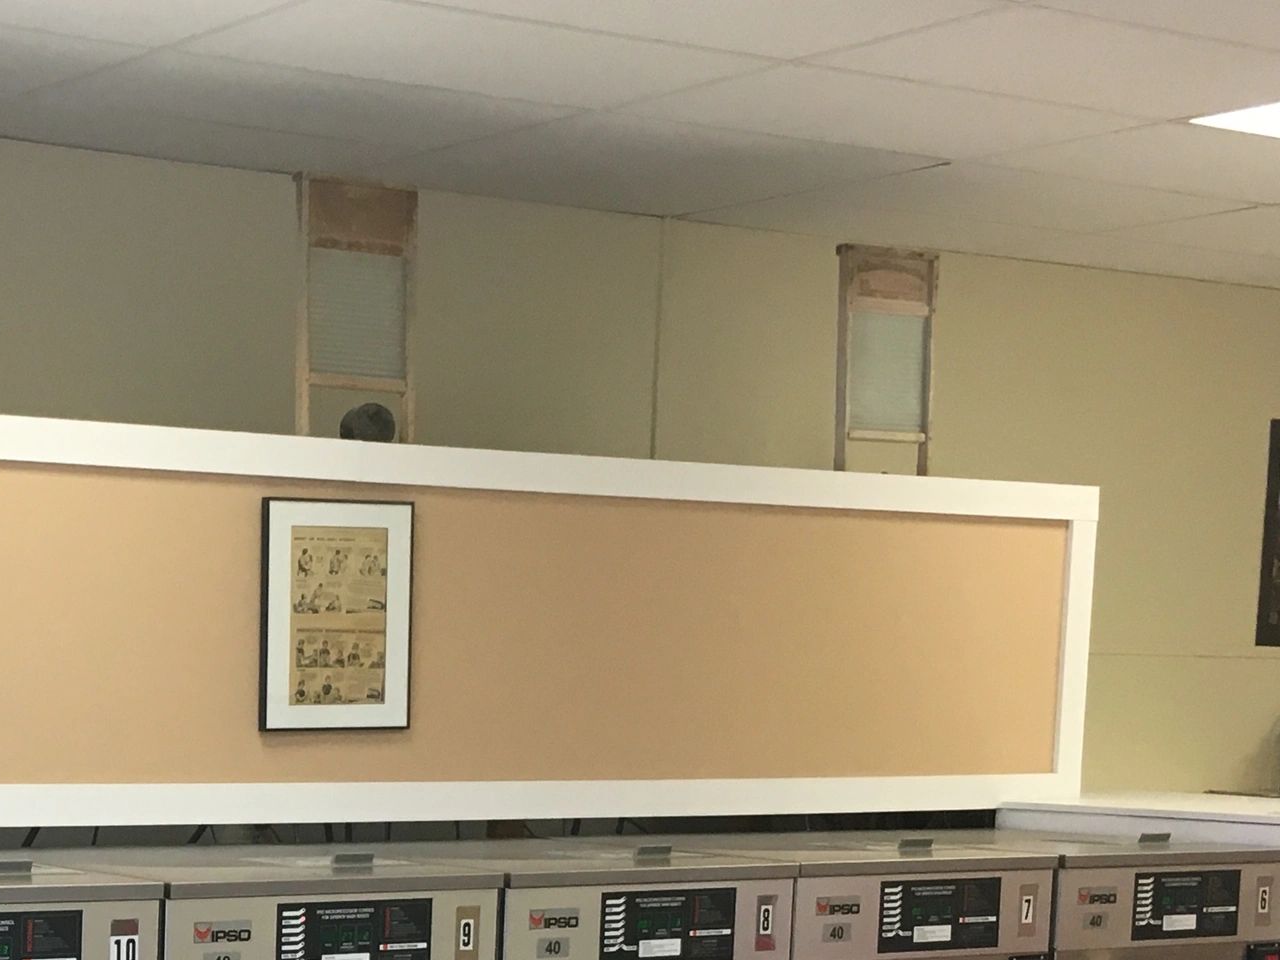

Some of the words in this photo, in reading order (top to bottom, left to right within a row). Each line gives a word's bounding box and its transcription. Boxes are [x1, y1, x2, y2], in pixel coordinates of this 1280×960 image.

[1260, 889, 1268, 910] 6
[829, 904, 861, 915] IPSO
[1024, 898, 1032, 920] 7
[544, 916, 579, 928] IPSO
[761, 907, 770, 932] 8
[211, 929, 251, 943] IPSO
[462, 921, 471, 947] 9
[830, 926, 844, 940] 40
[545, 940, 561, 955] 40
